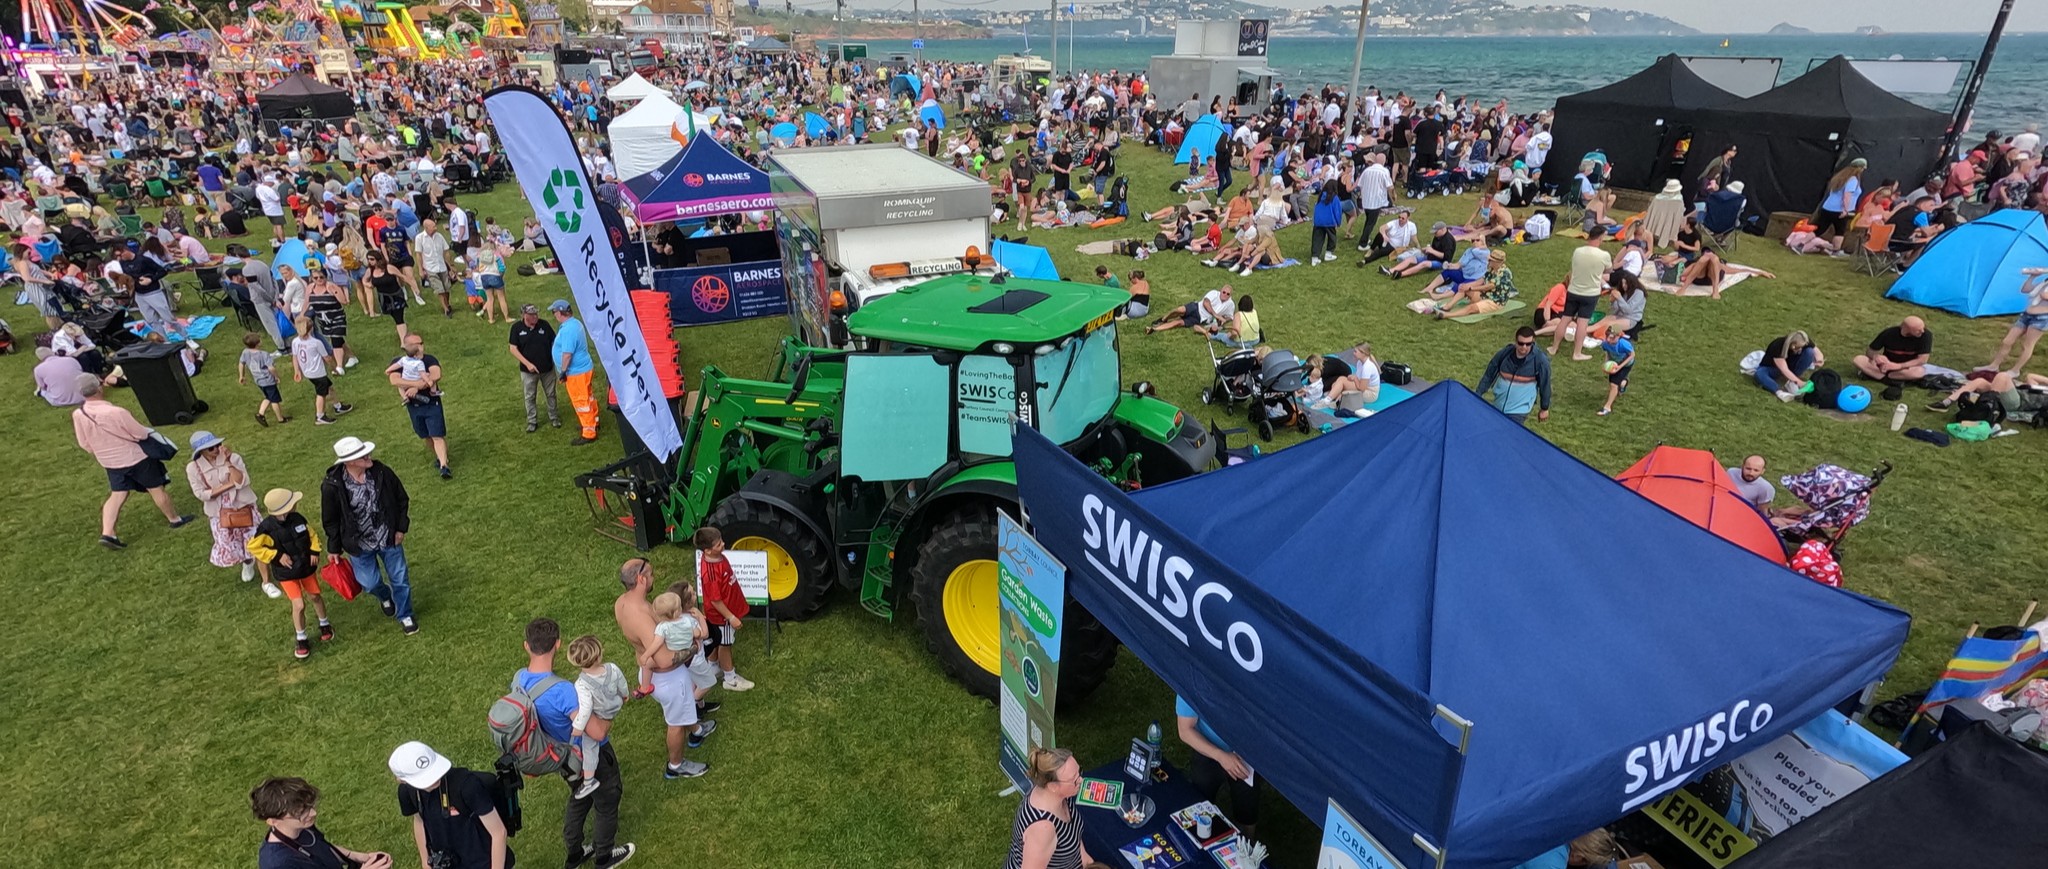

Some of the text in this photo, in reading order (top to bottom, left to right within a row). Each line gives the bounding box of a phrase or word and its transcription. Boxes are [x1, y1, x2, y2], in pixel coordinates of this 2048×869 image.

[706, 172, 751, 182] BARNES
[886, 208, 934, 219] RECYCLING
[733, 267, 781, 282] BARNES
[911, 261, 961, 274] RECYCLING
[580, 233, 658, 419] Recycle Here
[960, 383, 1016, 400] SWISCo
[1018, 391, 1029, 423] WISCo
[961, 413, 1011, 425] #TeamSWISC
[1001, 568, 1054, 630] Garden Waste
[1001, 581, 1030, 618] COLLECTIONS
[1082, 493, 1264, 673] SWISCo
[1624, 699, 1774, 794] SWISCo
[1773, 751, 1837, 799] Place your
[1775, 773, 1819, 807] sealed,
[1754, 777, 1762, 788] it
[1763, 787, 1778, 800] on
[1779, 797, 1798, 816] top
[1153, 833, 1168, 846] ECO
